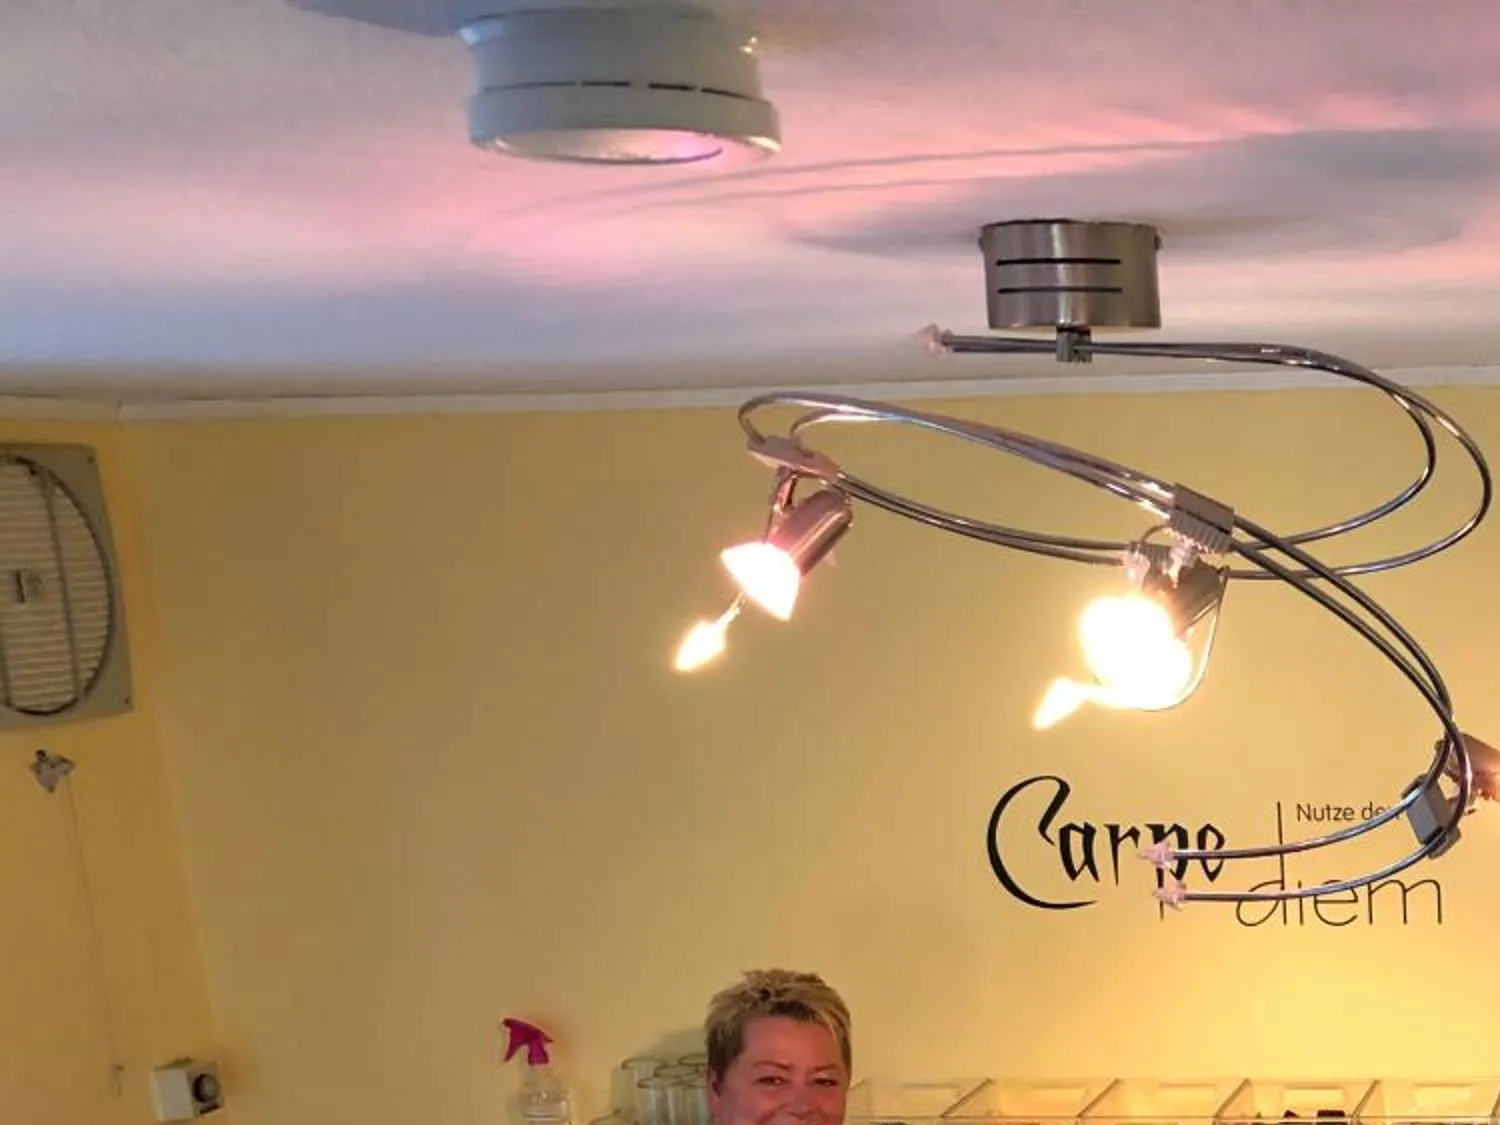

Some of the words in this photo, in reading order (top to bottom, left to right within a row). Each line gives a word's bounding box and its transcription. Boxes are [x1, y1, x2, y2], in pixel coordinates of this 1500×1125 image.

[986, 775, 1226, 921] Carpe
[1236, 801, 1443, 927] diem
[1296, 802, 1355, 822] Nutze
[1361, 801, 1400, 821] de
